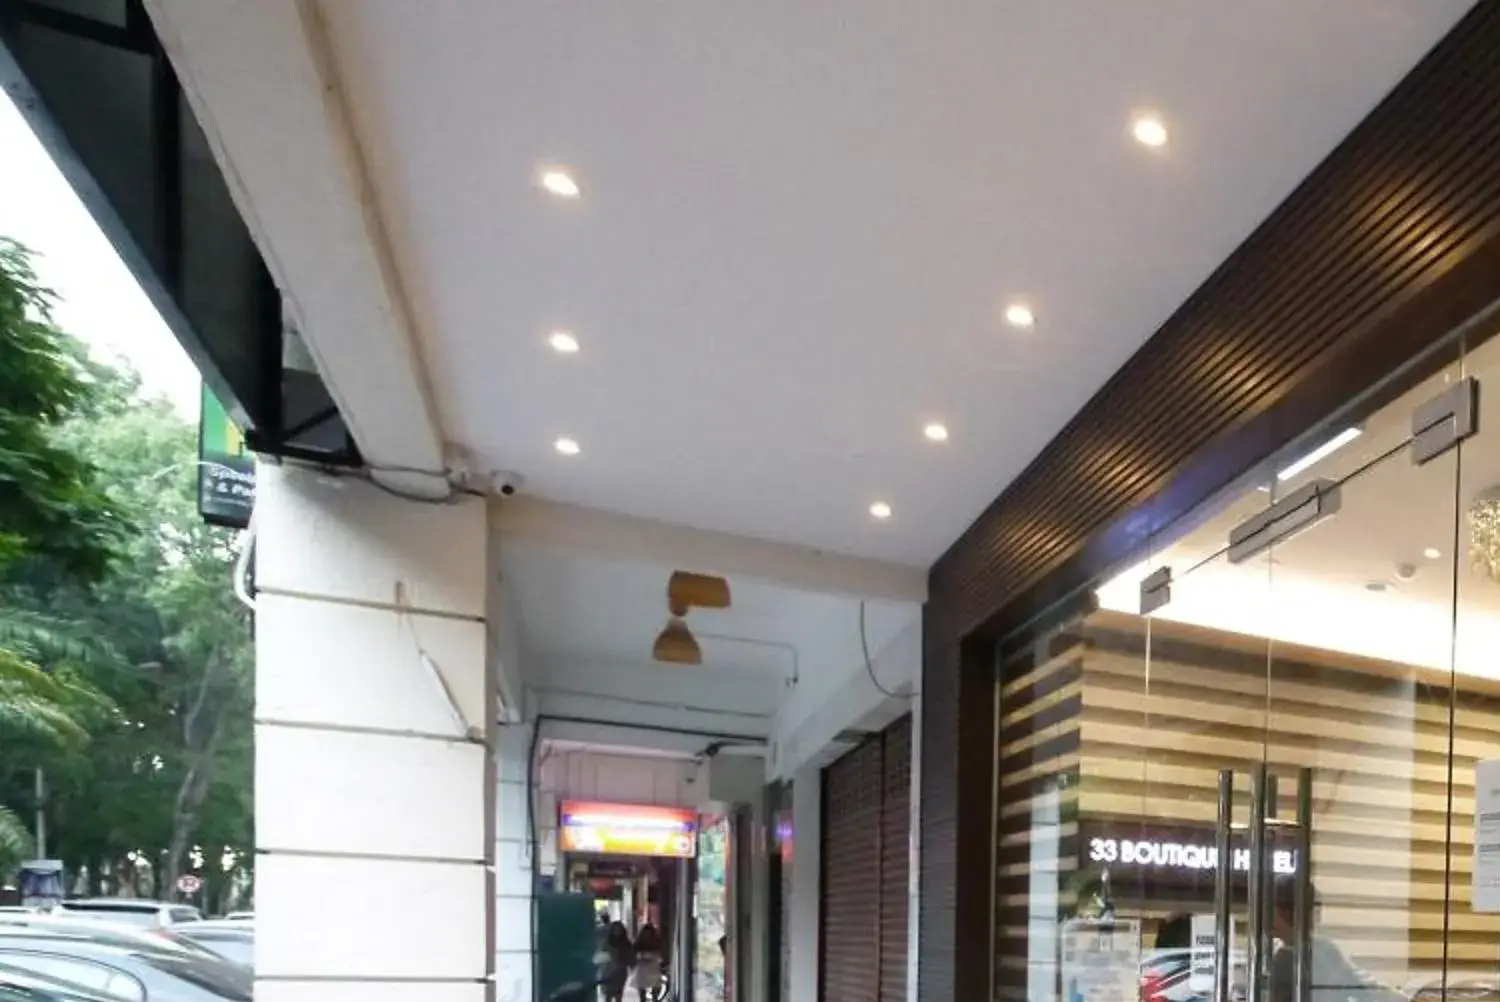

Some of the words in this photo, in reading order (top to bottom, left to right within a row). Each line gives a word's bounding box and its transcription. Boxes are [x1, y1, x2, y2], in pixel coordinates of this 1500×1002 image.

[1089, 838, 1117, 861] 33
[1119, 840, 1220, 869] BOUTIQU
[1233, 846, 1297, 874] HEL
